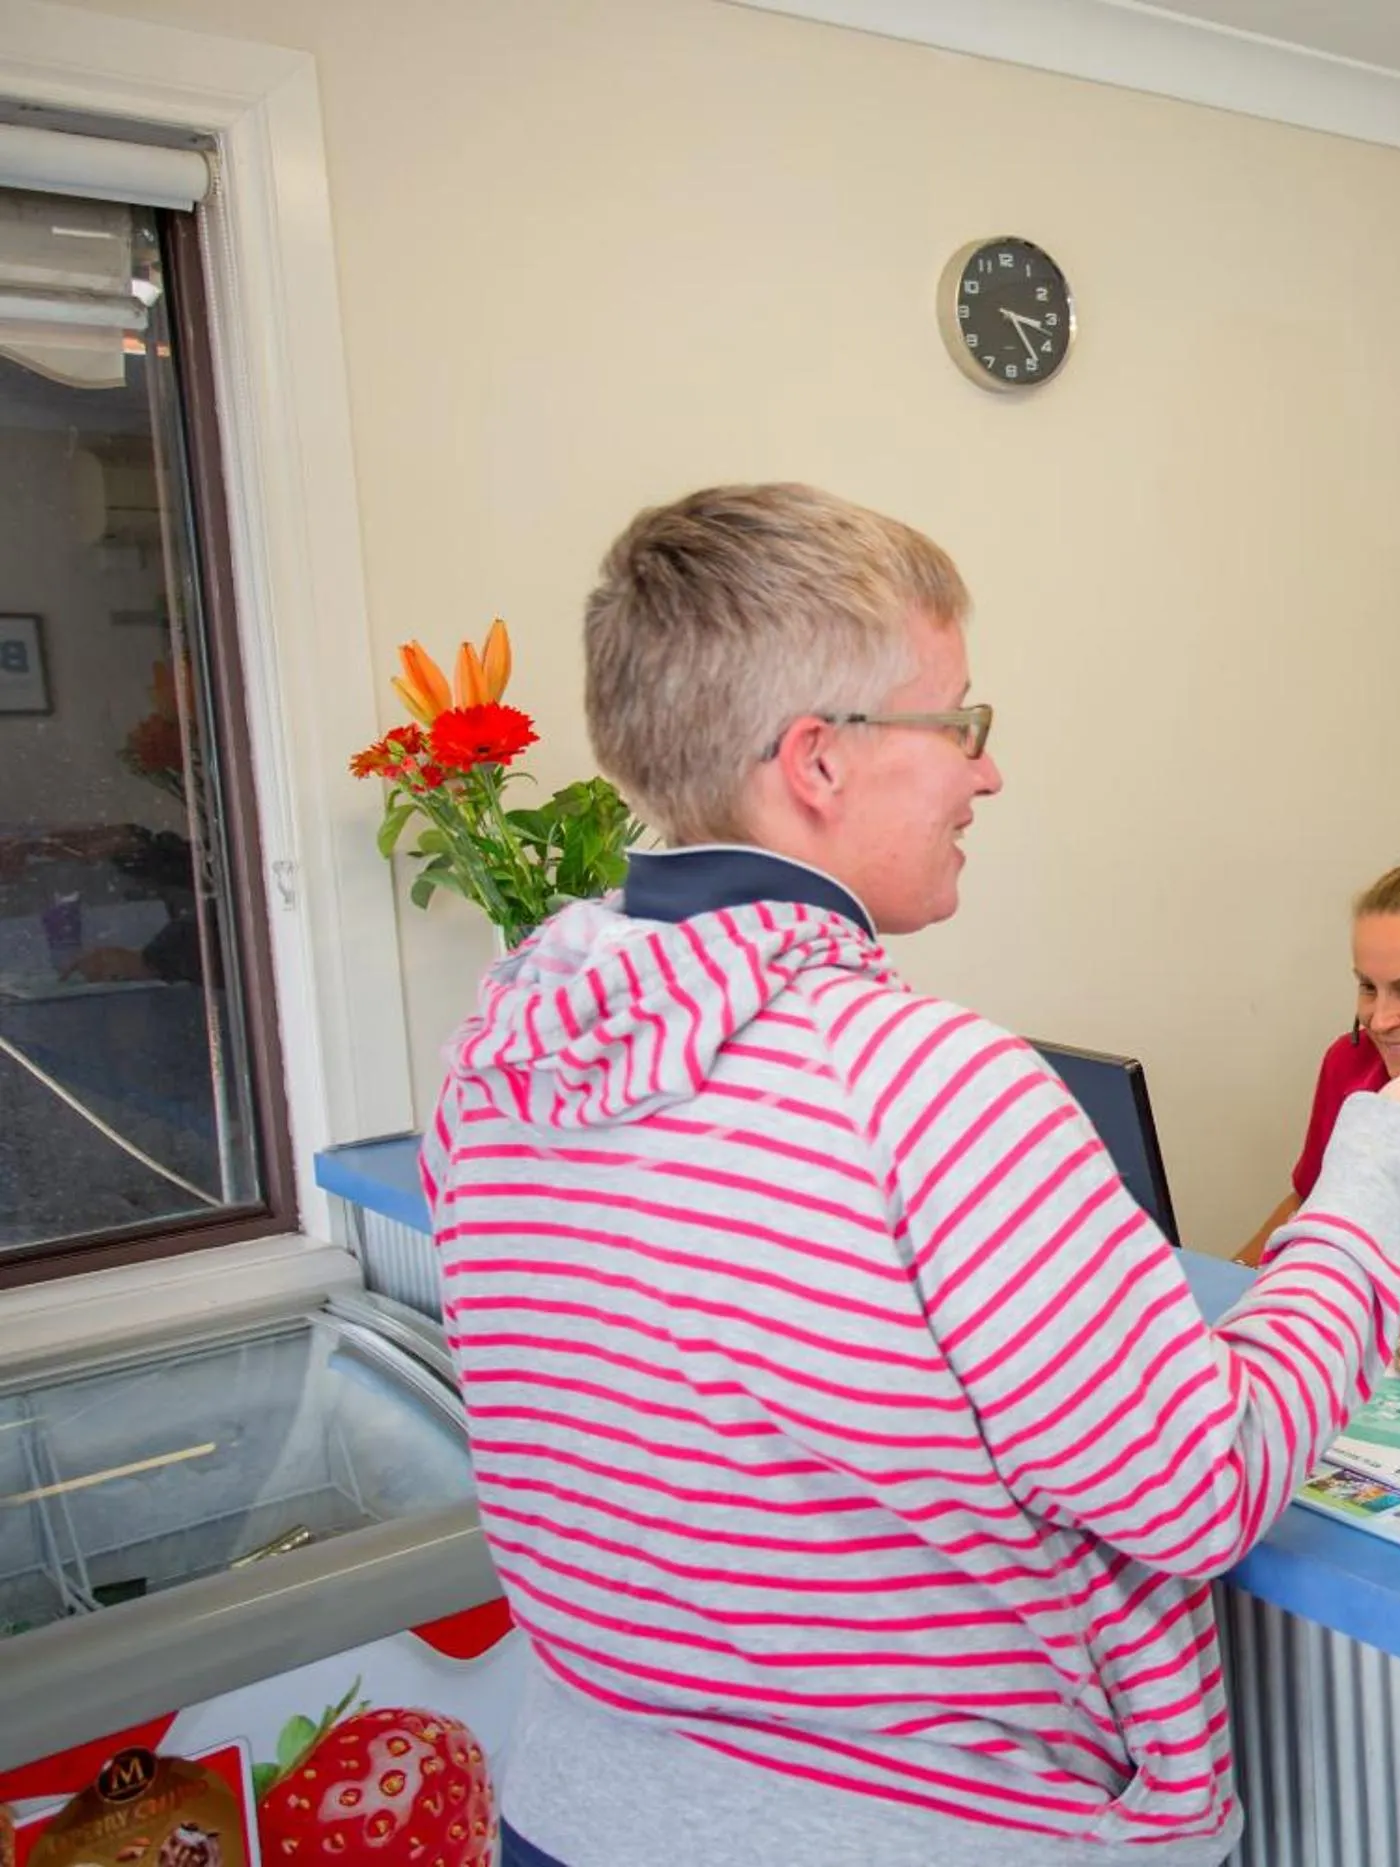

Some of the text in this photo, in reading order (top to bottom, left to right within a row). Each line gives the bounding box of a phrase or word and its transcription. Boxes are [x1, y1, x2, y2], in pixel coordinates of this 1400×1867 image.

[978, 259, 993, 274] 11
[999, 253, 1014, 267] 12
[964, 280, 980, 294] 10
[1035, 287, 1048, 301] 2
[1045, 312, 1058, 326] 3
[1040, 339, 1052, 352] 4
[982, 355, 996, 369] 7
[111, 1756, 145, 1789] M
